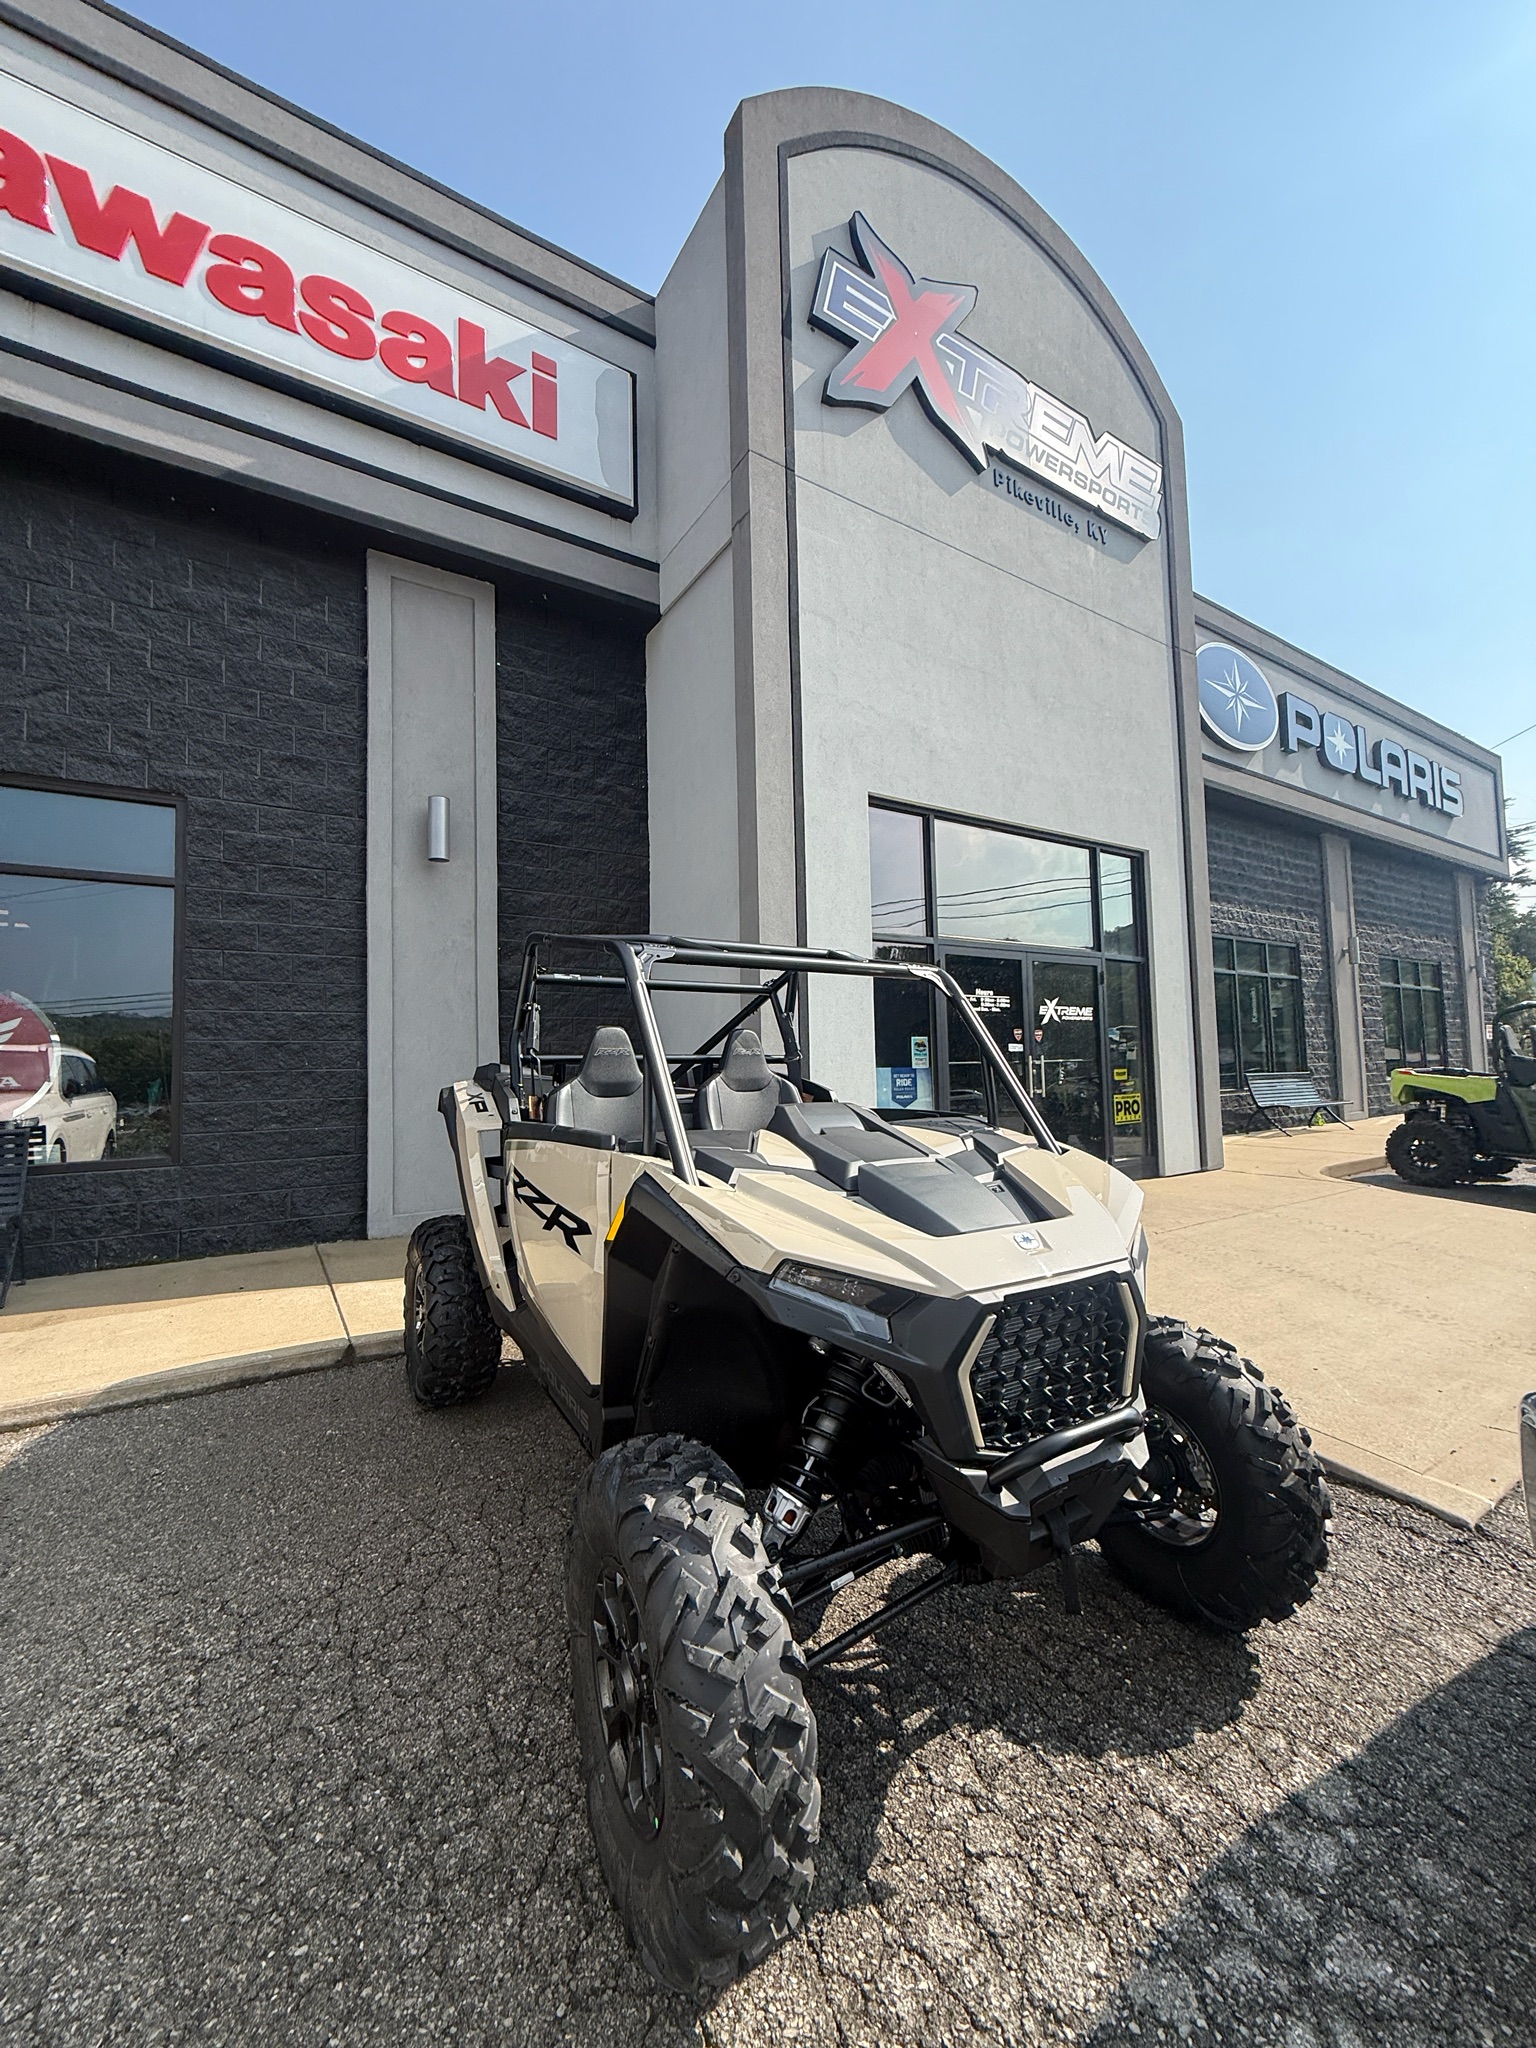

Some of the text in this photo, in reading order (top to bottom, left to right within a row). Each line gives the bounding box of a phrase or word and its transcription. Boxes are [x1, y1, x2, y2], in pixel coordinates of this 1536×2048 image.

[822, 236, 1159, 509] EXTREME
[1086, 518, 1108, 545] KY
[1278, 691, 1464, 818] POLARIS
[1039, 996, 1094, 1025] EXTREME
[896, 1078, 913, 1087] RIDE
[1115, 1099, 1140, 1116] PRO
[506, 1162, 592, 1256] RZR
[539, 1356, 590, 1431] POLARIS
